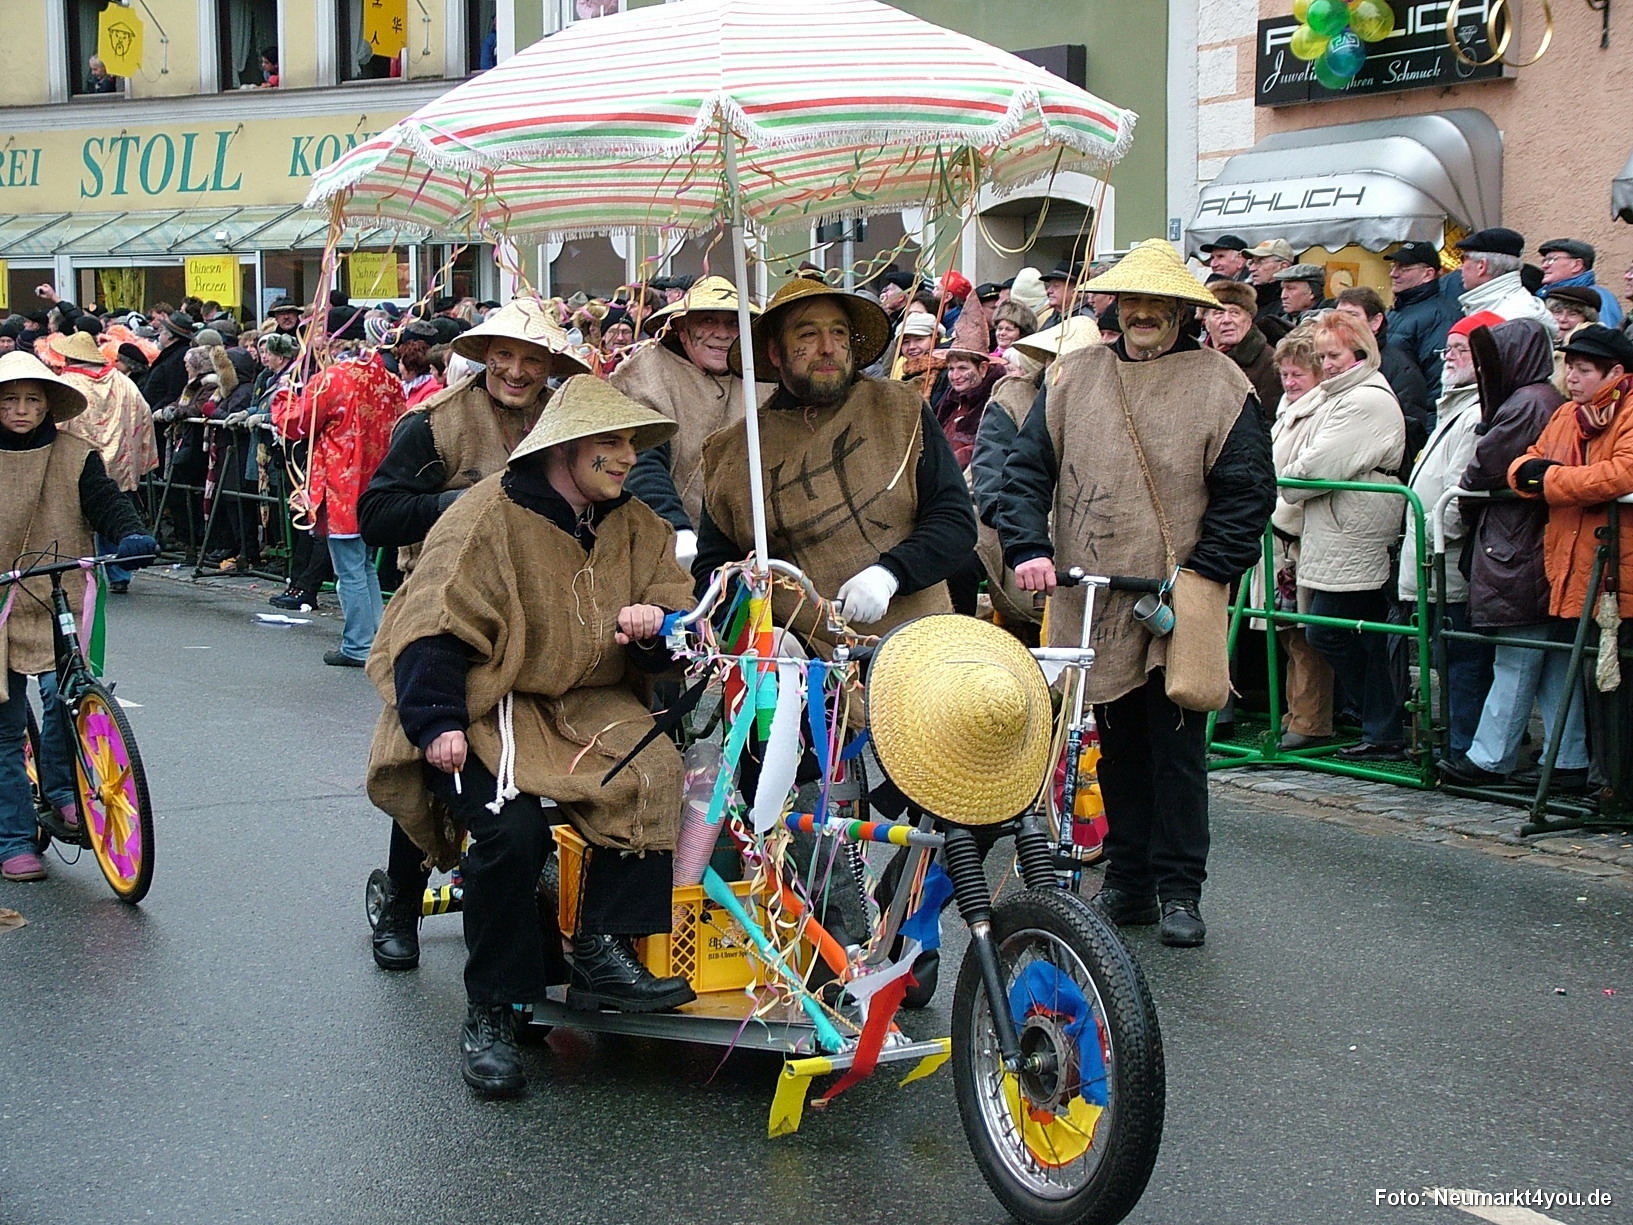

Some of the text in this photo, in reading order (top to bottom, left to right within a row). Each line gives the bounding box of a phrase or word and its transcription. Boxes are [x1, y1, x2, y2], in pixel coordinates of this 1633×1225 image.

[1382, 55, 1442, 85] Schmuck
[81, 131, 243, 199] STOLL
[1197, 186, 1366, 219] RÖHLICH
[190, 260, 222, 274] Chinesen
